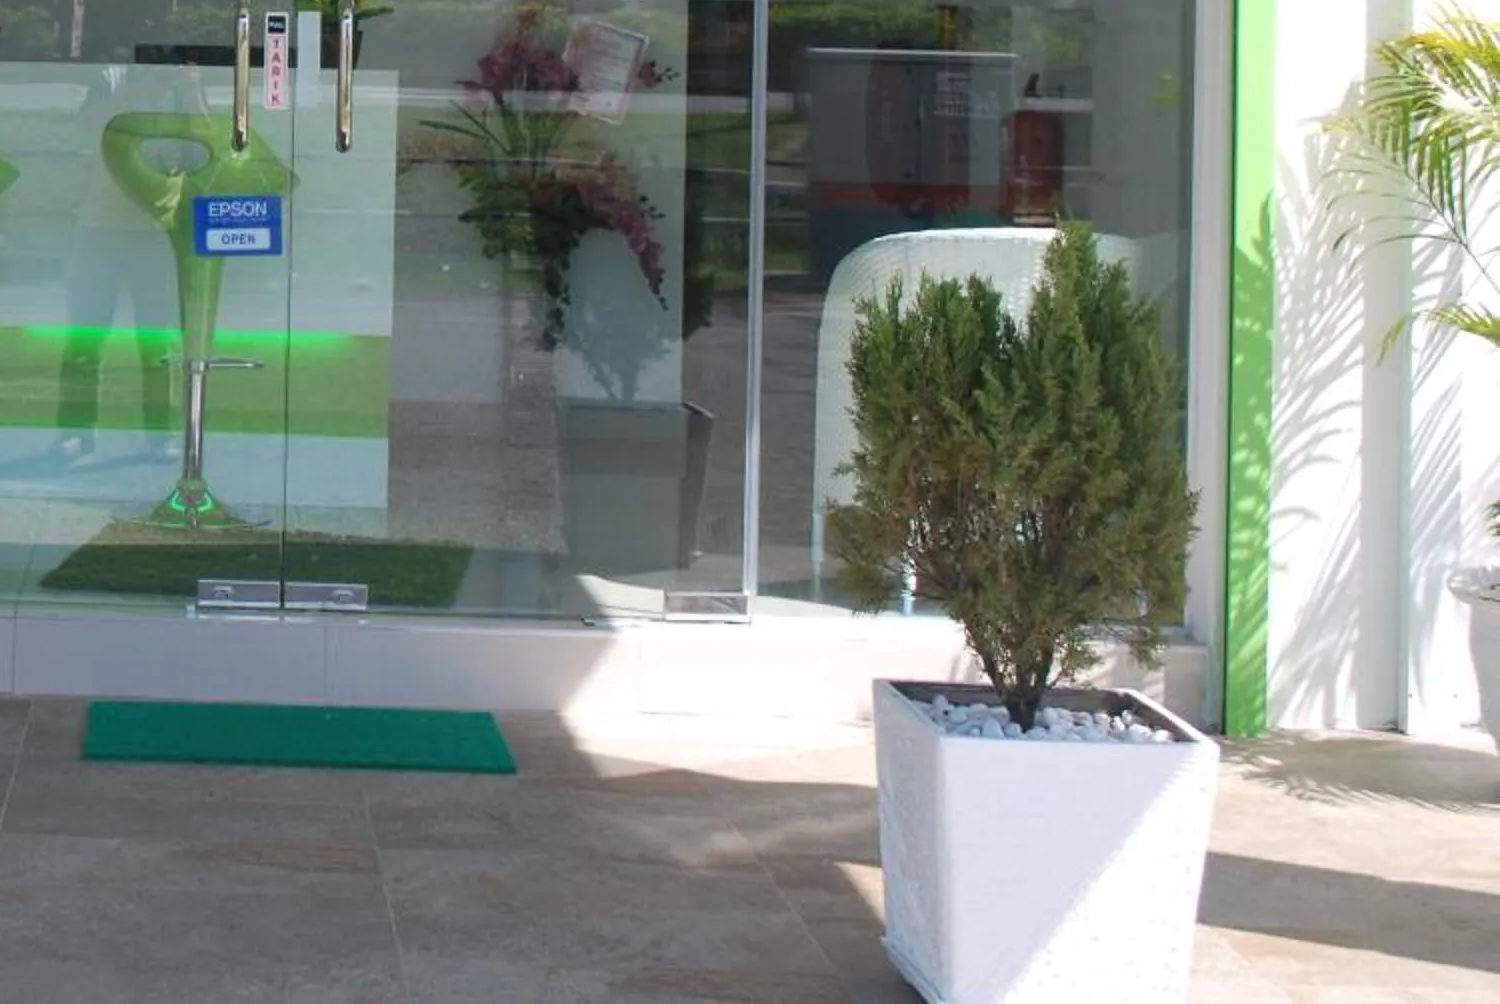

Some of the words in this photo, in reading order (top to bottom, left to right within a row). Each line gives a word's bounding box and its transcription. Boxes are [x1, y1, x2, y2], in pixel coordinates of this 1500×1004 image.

[270, 38, 282, 105] TARIK
[208, 200, 267, 217] EPSON
[220, 233, 257, 245] OPEN
